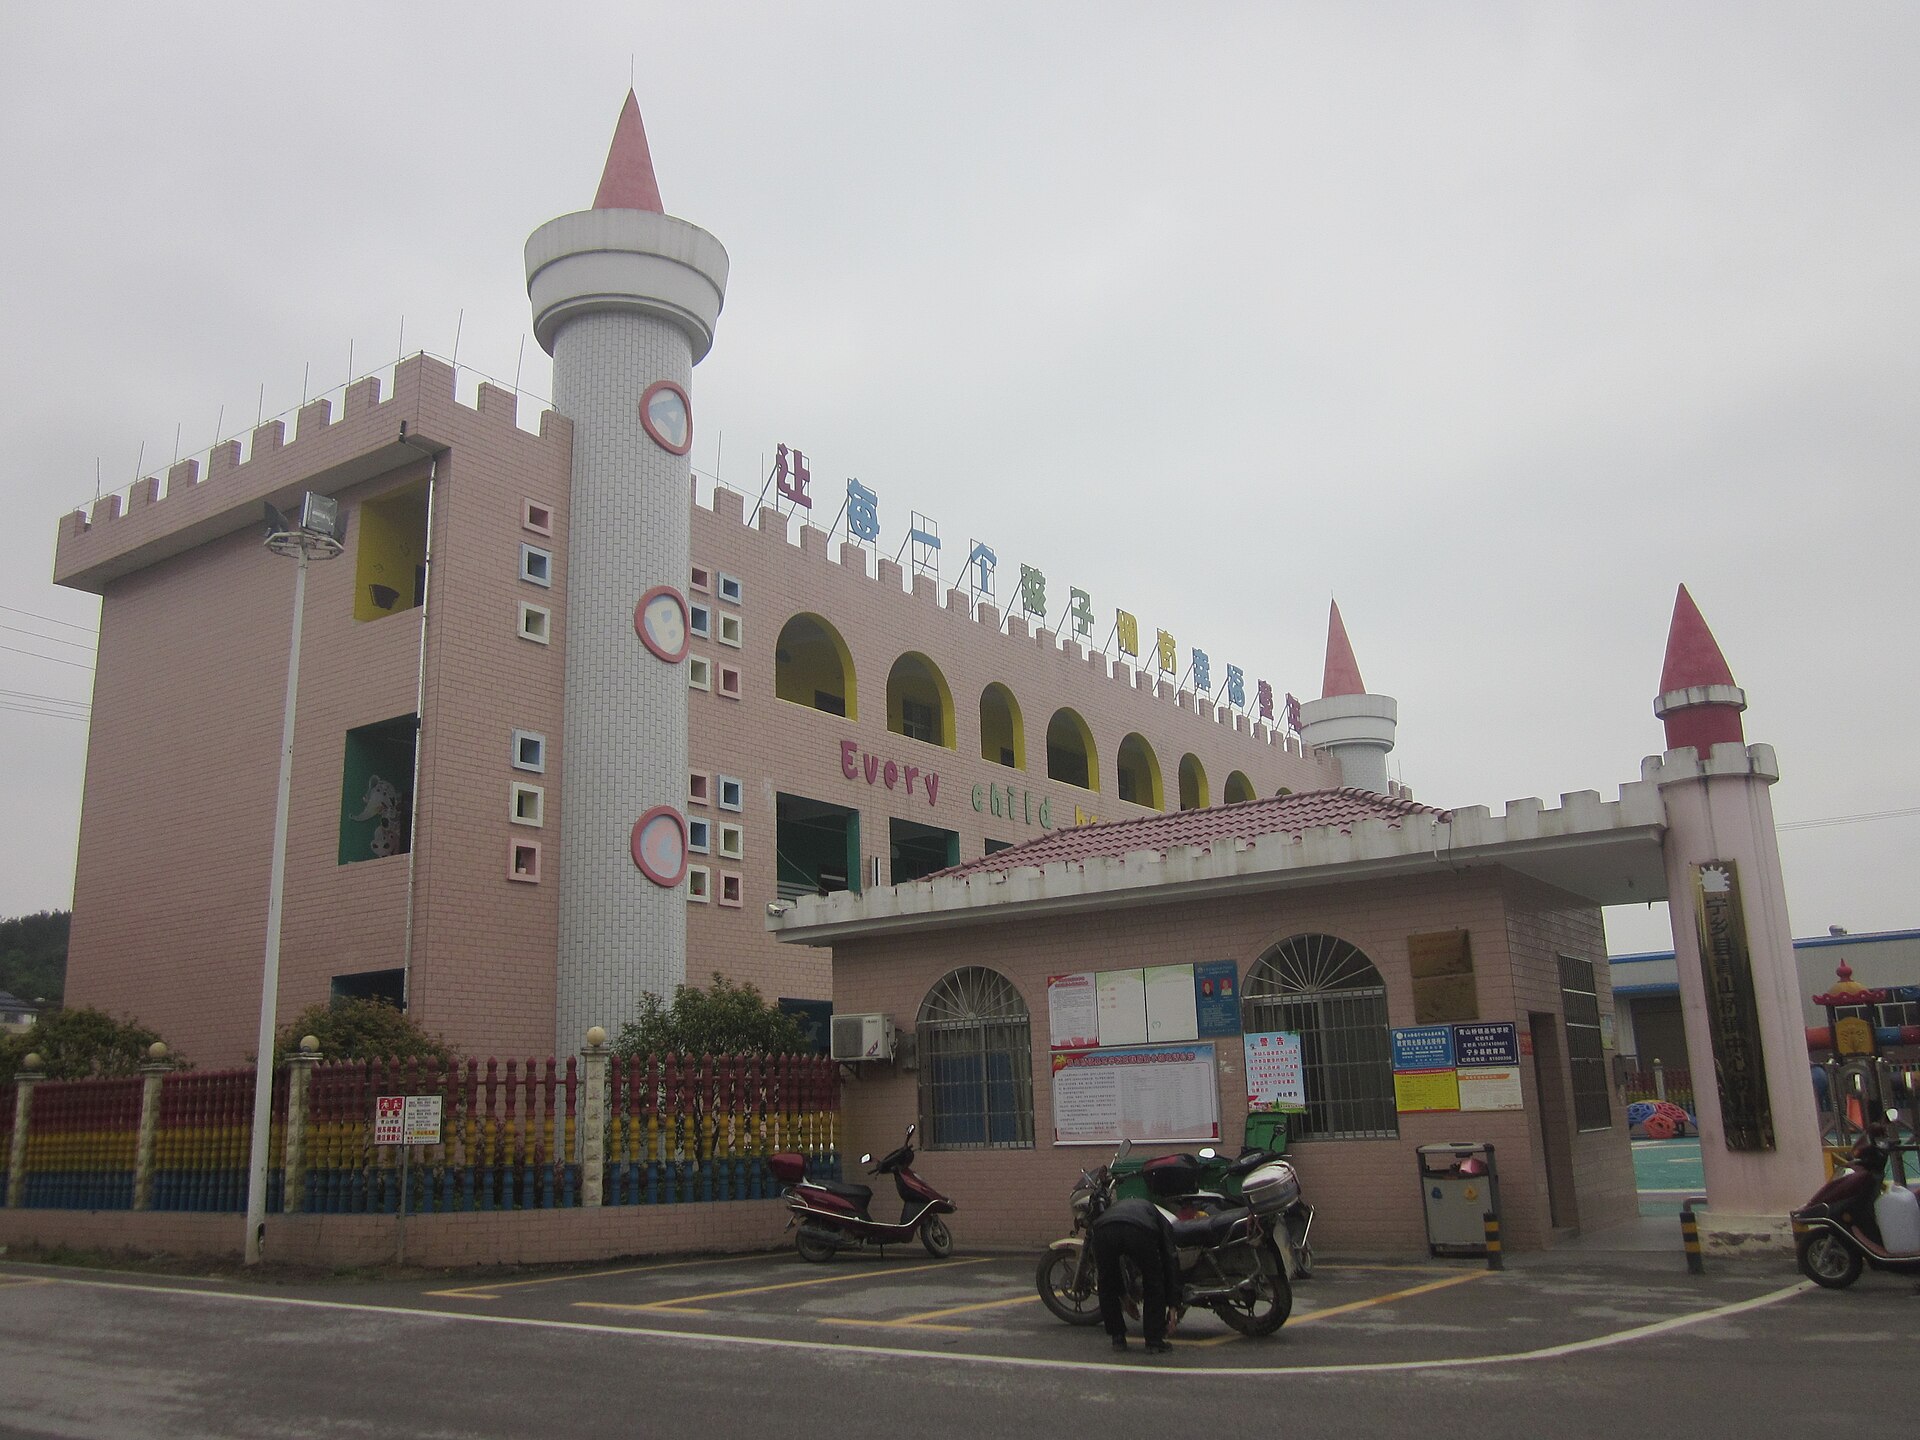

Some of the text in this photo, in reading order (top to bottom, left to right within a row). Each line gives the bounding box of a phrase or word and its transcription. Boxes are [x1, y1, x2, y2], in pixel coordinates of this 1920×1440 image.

[777, 443, 1301, 734] 让每一个孩子拥有幸福童年
[840, 740, 939, 807] Every
[971, 782, 1052, 830] child
